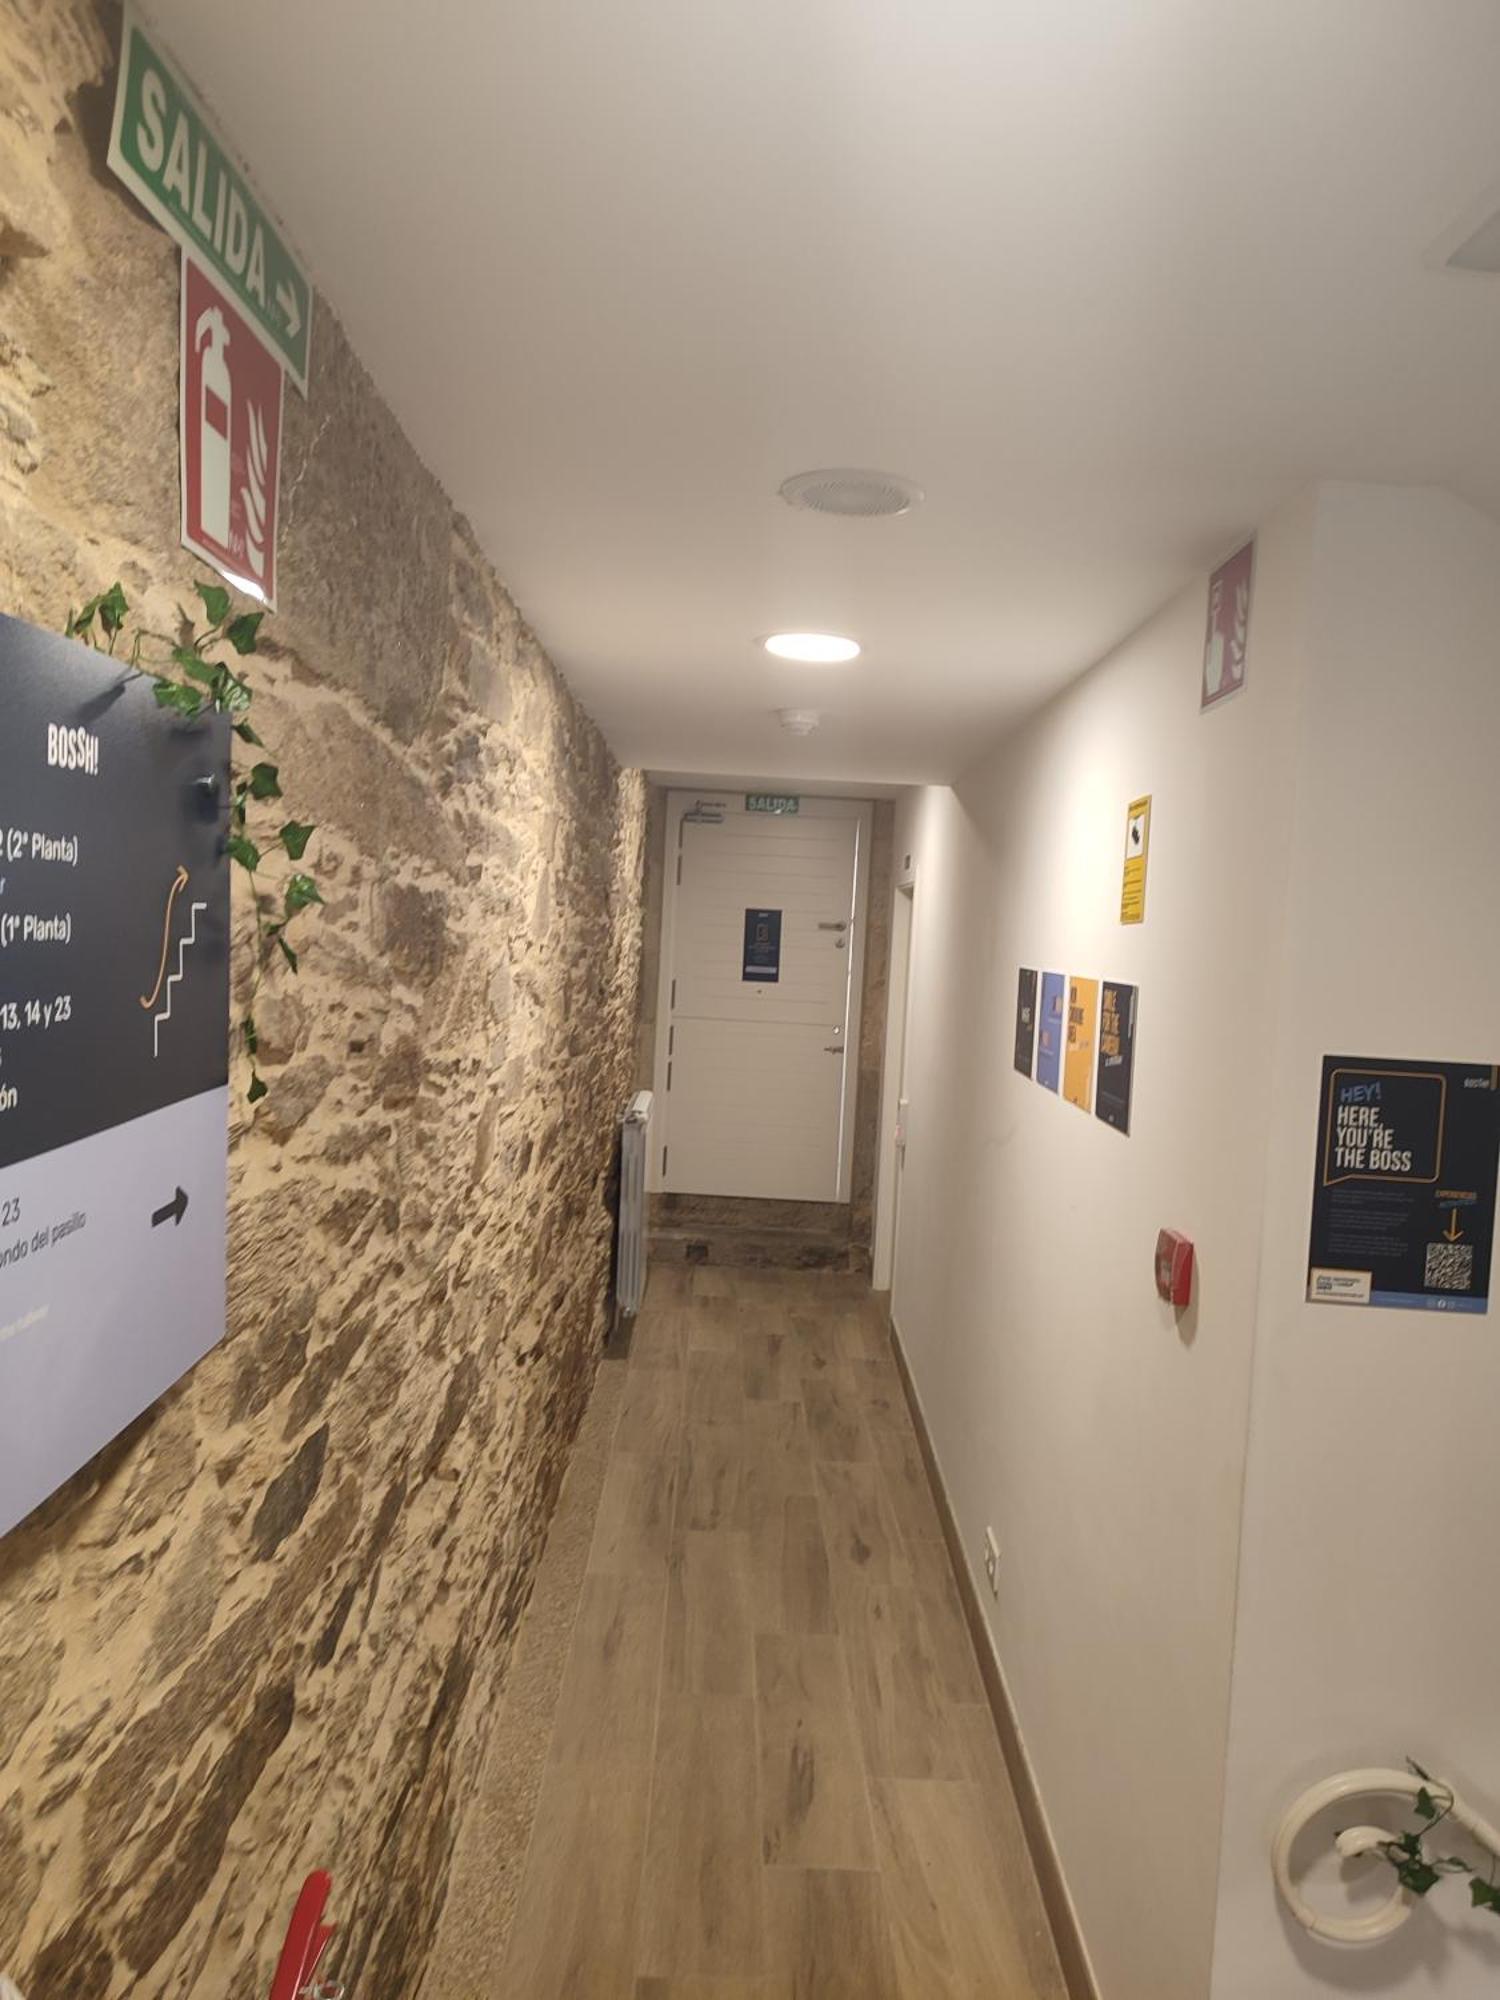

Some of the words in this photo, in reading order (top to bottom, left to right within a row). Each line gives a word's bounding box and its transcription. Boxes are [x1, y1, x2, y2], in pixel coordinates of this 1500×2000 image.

[137, 67, 266, 310] SALIDA
[47, 722, 99, 776] BOSSH!
[748, 797, 795, 813] SALIDA
[31, 831, 78, 867] Planta)
[23, 912, 71, 945] Planta)
[24, 999, 40, 1027] 14
[43, 1003, 52, 1030] y
[54, 995, 71, 1022] 23
[1340, 1081, 1382, 1103] HEY!
[1336, 1125, 1394, 1149] YOU'RE
[1334, 1147, 1366, 1169] THE
[1368, 1149, 1412, 1172] BOSS
[2, 1197, 21, 1227] 23
[31, 1226, 49, 1253] del
